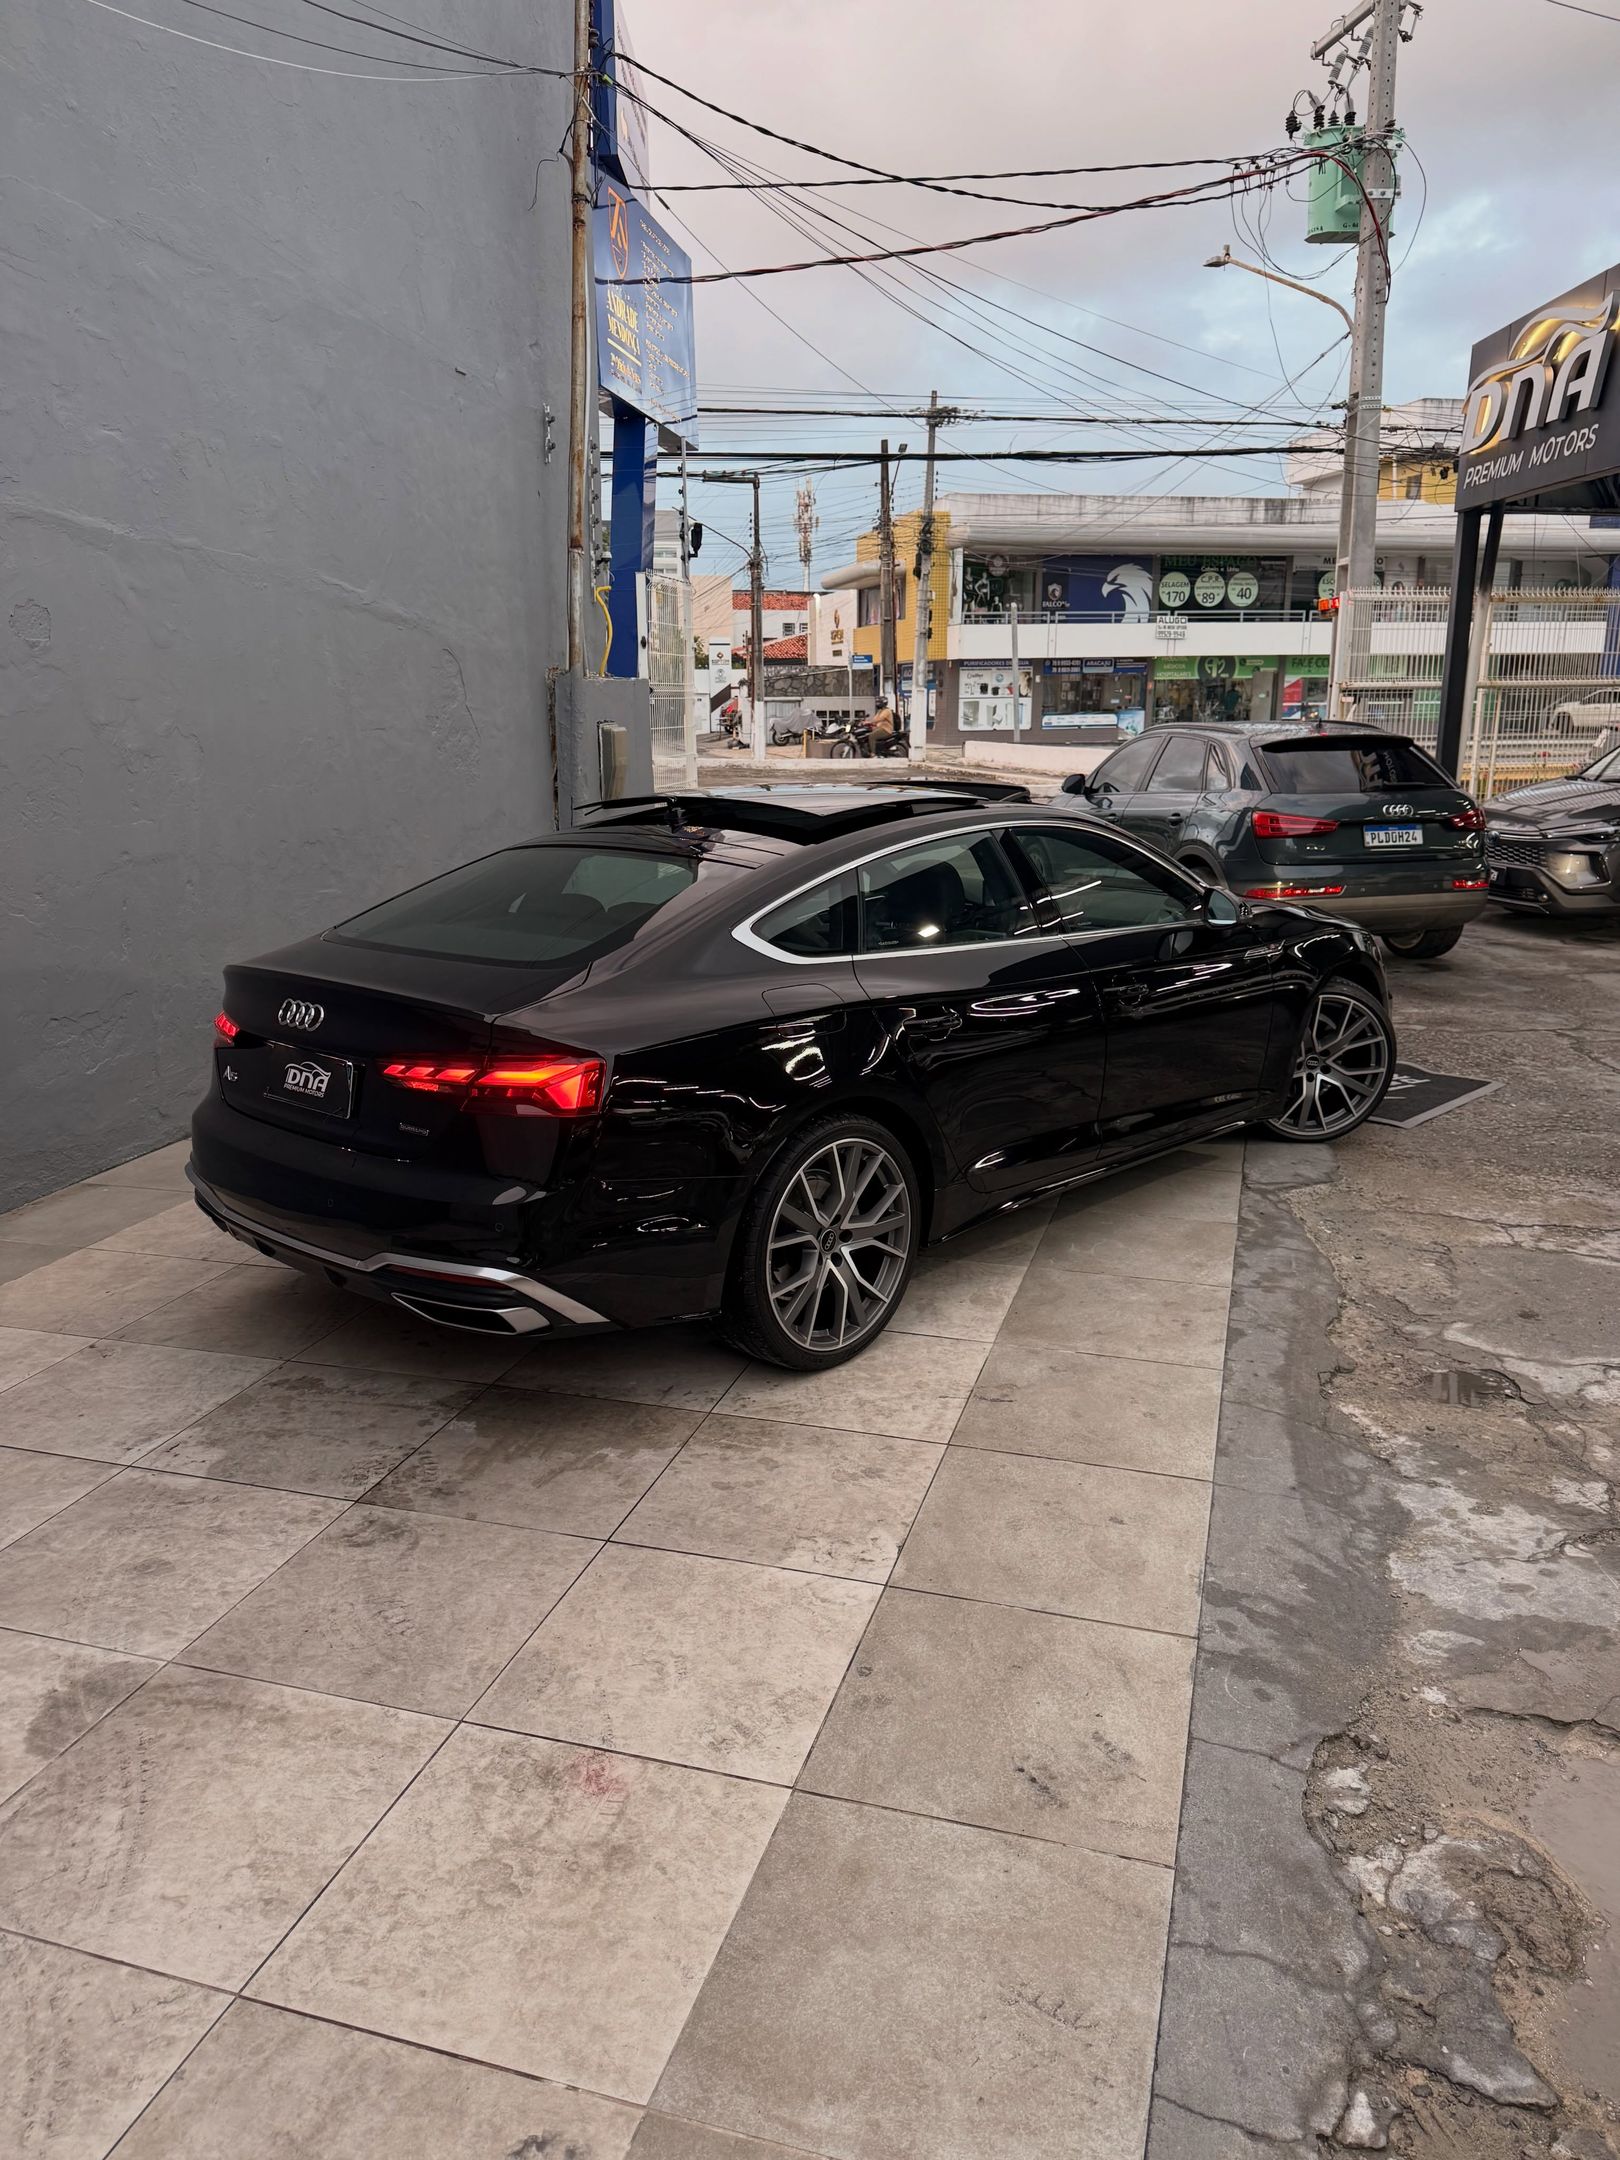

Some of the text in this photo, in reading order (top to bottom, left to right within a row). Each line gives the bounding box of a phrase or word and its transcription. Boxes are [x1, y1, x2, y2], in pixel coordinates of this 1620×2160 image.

[1460, 330, 1614, 455] DNA
[1463, 423, 1600, 490] PREMIUM MOTORS
[1160, 581, 1189, 589] SELAGEM
[1166, 591, 1186, 603] 170
[1201, 592, 1216, 604] 89
[1236, 587, 1252, 600] 40
[1158, 616, 1187, 624] ALUGO
[285, 1067, 330, 1093] DNA
[283, 1082, 325, 1098] PREMIUM MOTORS
